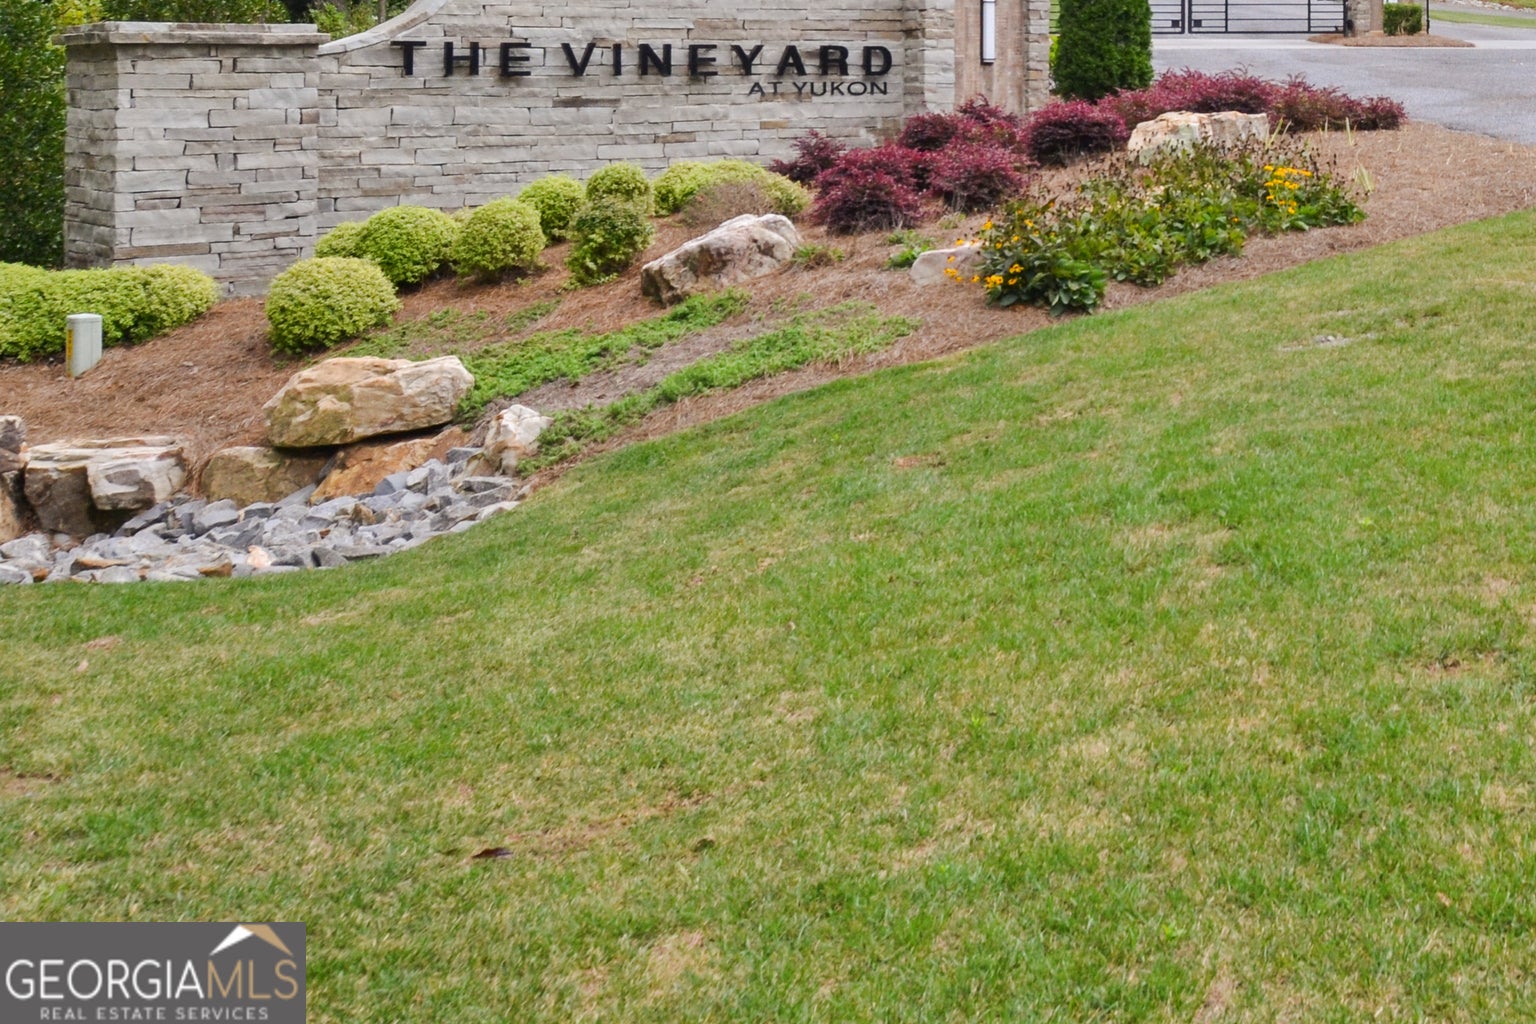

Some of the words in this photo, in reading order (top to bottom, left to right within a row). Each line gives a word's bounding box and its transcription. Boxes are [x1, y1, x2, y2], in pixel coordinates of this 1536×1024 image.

[391, 40, 532, 77] THE
[561, 42, 893, 77] VINEYARD
[748, 81, 783, 97] AT
[792, 81, 888, 97] YUKON
